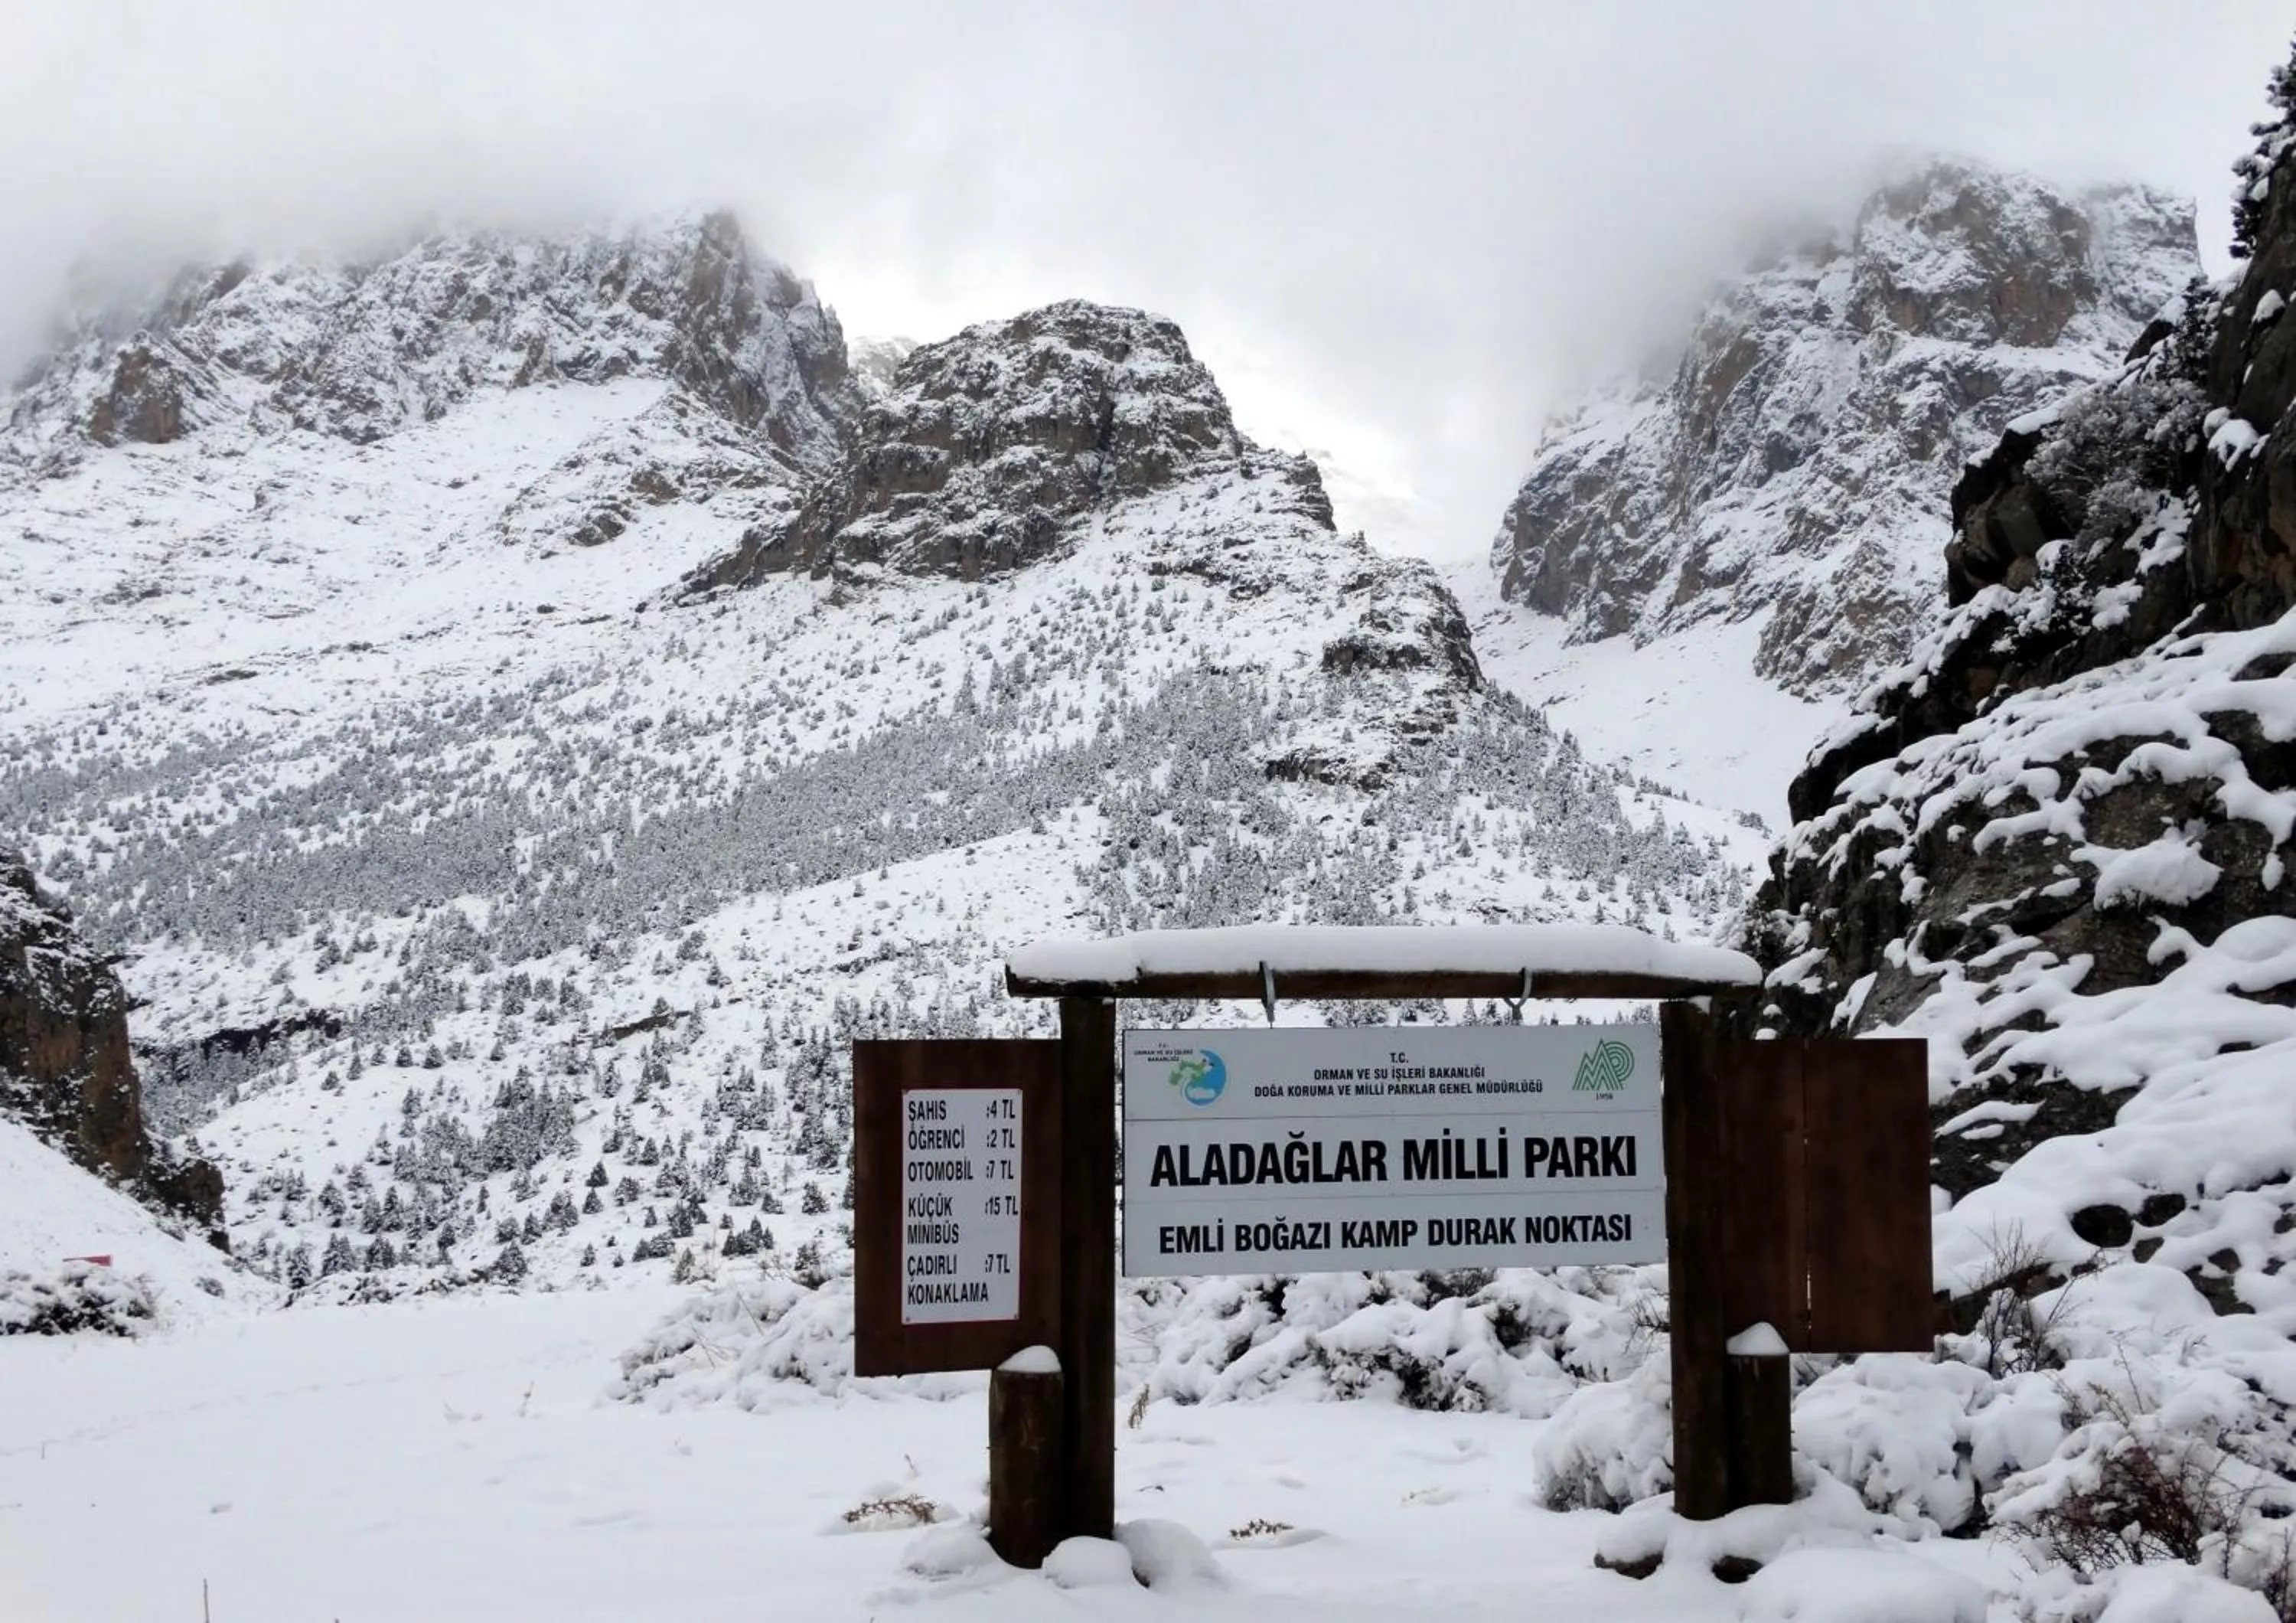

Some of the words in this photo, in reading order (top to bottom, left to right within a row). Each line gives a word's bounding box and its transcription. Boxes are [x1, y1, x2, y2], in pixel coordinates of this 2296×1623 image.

[1390, 1053, 1408, 1063] T.C.
[1314, 1069, 1354, 1080] ORMAN
[1357, 1069, 1370, 1079] VE
[1374, 1068, 1388, 1079] SU
[1392, 1065, 1425, 1081] İŞLERİ
[1429, 1064, 1485, 1079] BAKANLIĞI
[1254, 1083, 1283, 1097] DOĞA
[1287, 1086, 1334, 1096] KORUMA
[1338, 1085, 1351, 1096] VE
[1355, 1082, 1384, 1096] MİLLİ
[1388, 1083, 1436, 1095] PARKLAR
[1439, 1083, 1473, 1094] GENEL
[1476, 1079, 1543, 1093] MÜDÜRLÜĞÜ
[908, 1099, 947, 1122] ŞAHIS
[1002, 1099, 1016, 1118] TL
[908, 1123, 965, 1150] ÖĞRENCİ
[1002, 1128, 1016, 1148] TL
[908, 1156, 974, 1182] OTOMOBİL
[1000, 1159, 1014, 1180] TL
[1150, 1131, 1388, 1187] ALADAĞLAR
[1403, 1127, 1508, 1181] MİLLİ
[1524, 1135, 1636, 1178] PARKI
[908, 1193, 953, 1221] KÜÇÜK
[1006, 1195, 1019, 1216] TL
[908, 1220, 959, 1244] MİNİBÜS
[1159, 1218, 1224, 1254] EMLİ
[1234, 1216, 1331, 1252] BOĞAZI
[1342, 1220, 1418, 1249] KAMP
[1427, 1216, 1516, 1246] DURAK
[1525, 1213, 1632, 1244] NOKTASI
[908, 1255, 957, 1281] ÇADIRLI
[996, 1254, 1010, 1274] TL
[908, 1282, 989, 1305] KONAKLAMA
